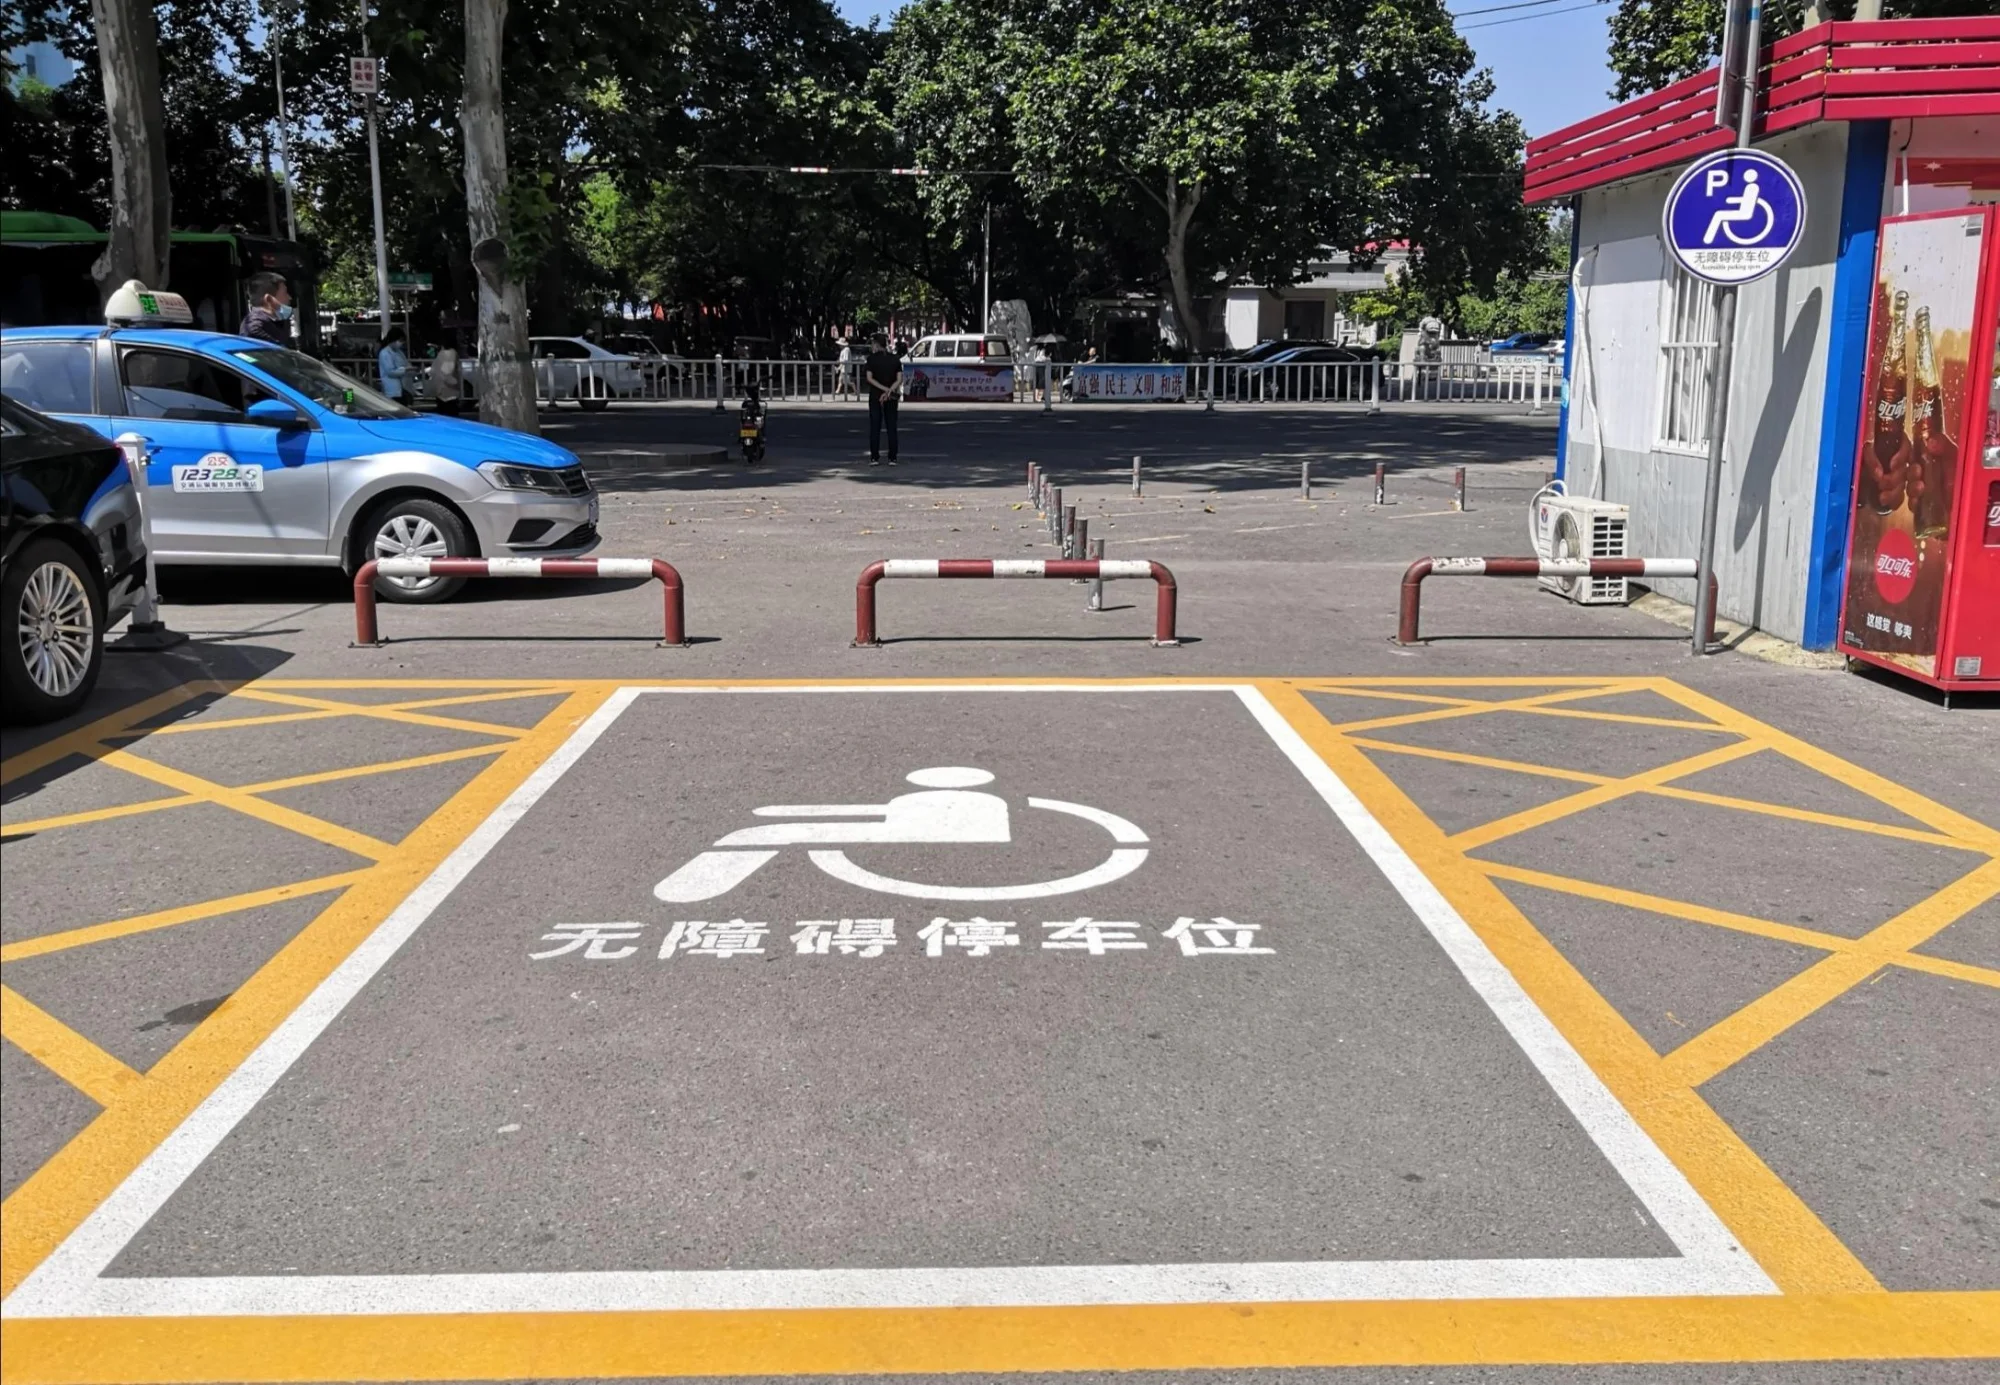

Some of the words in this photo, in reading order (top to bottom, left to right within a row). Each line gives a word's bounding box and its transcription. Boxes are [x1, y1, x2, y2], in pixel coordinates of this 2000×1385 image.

[1706, 170, 1729, 197] P
[1694, 250, 1770, 264] 无障碍停车位
[1078, 372, 1100, 396] 富强
[1106, 373, 1127, 396] 民主
[1132, 373, 1155, 396] 文明
[1160, 373, 1182, 396] 和谐
[207, 456, 228, 466] 公交
[181, 468, 239, 480] 12328
[1877, 553, 1915, 579] 可口可乐
[1866, 612, 1891, 633] 这感觉
[1894, 620, 1913, 640] 够爽
[528, 916, 1277, 960] 无障碍停车位
